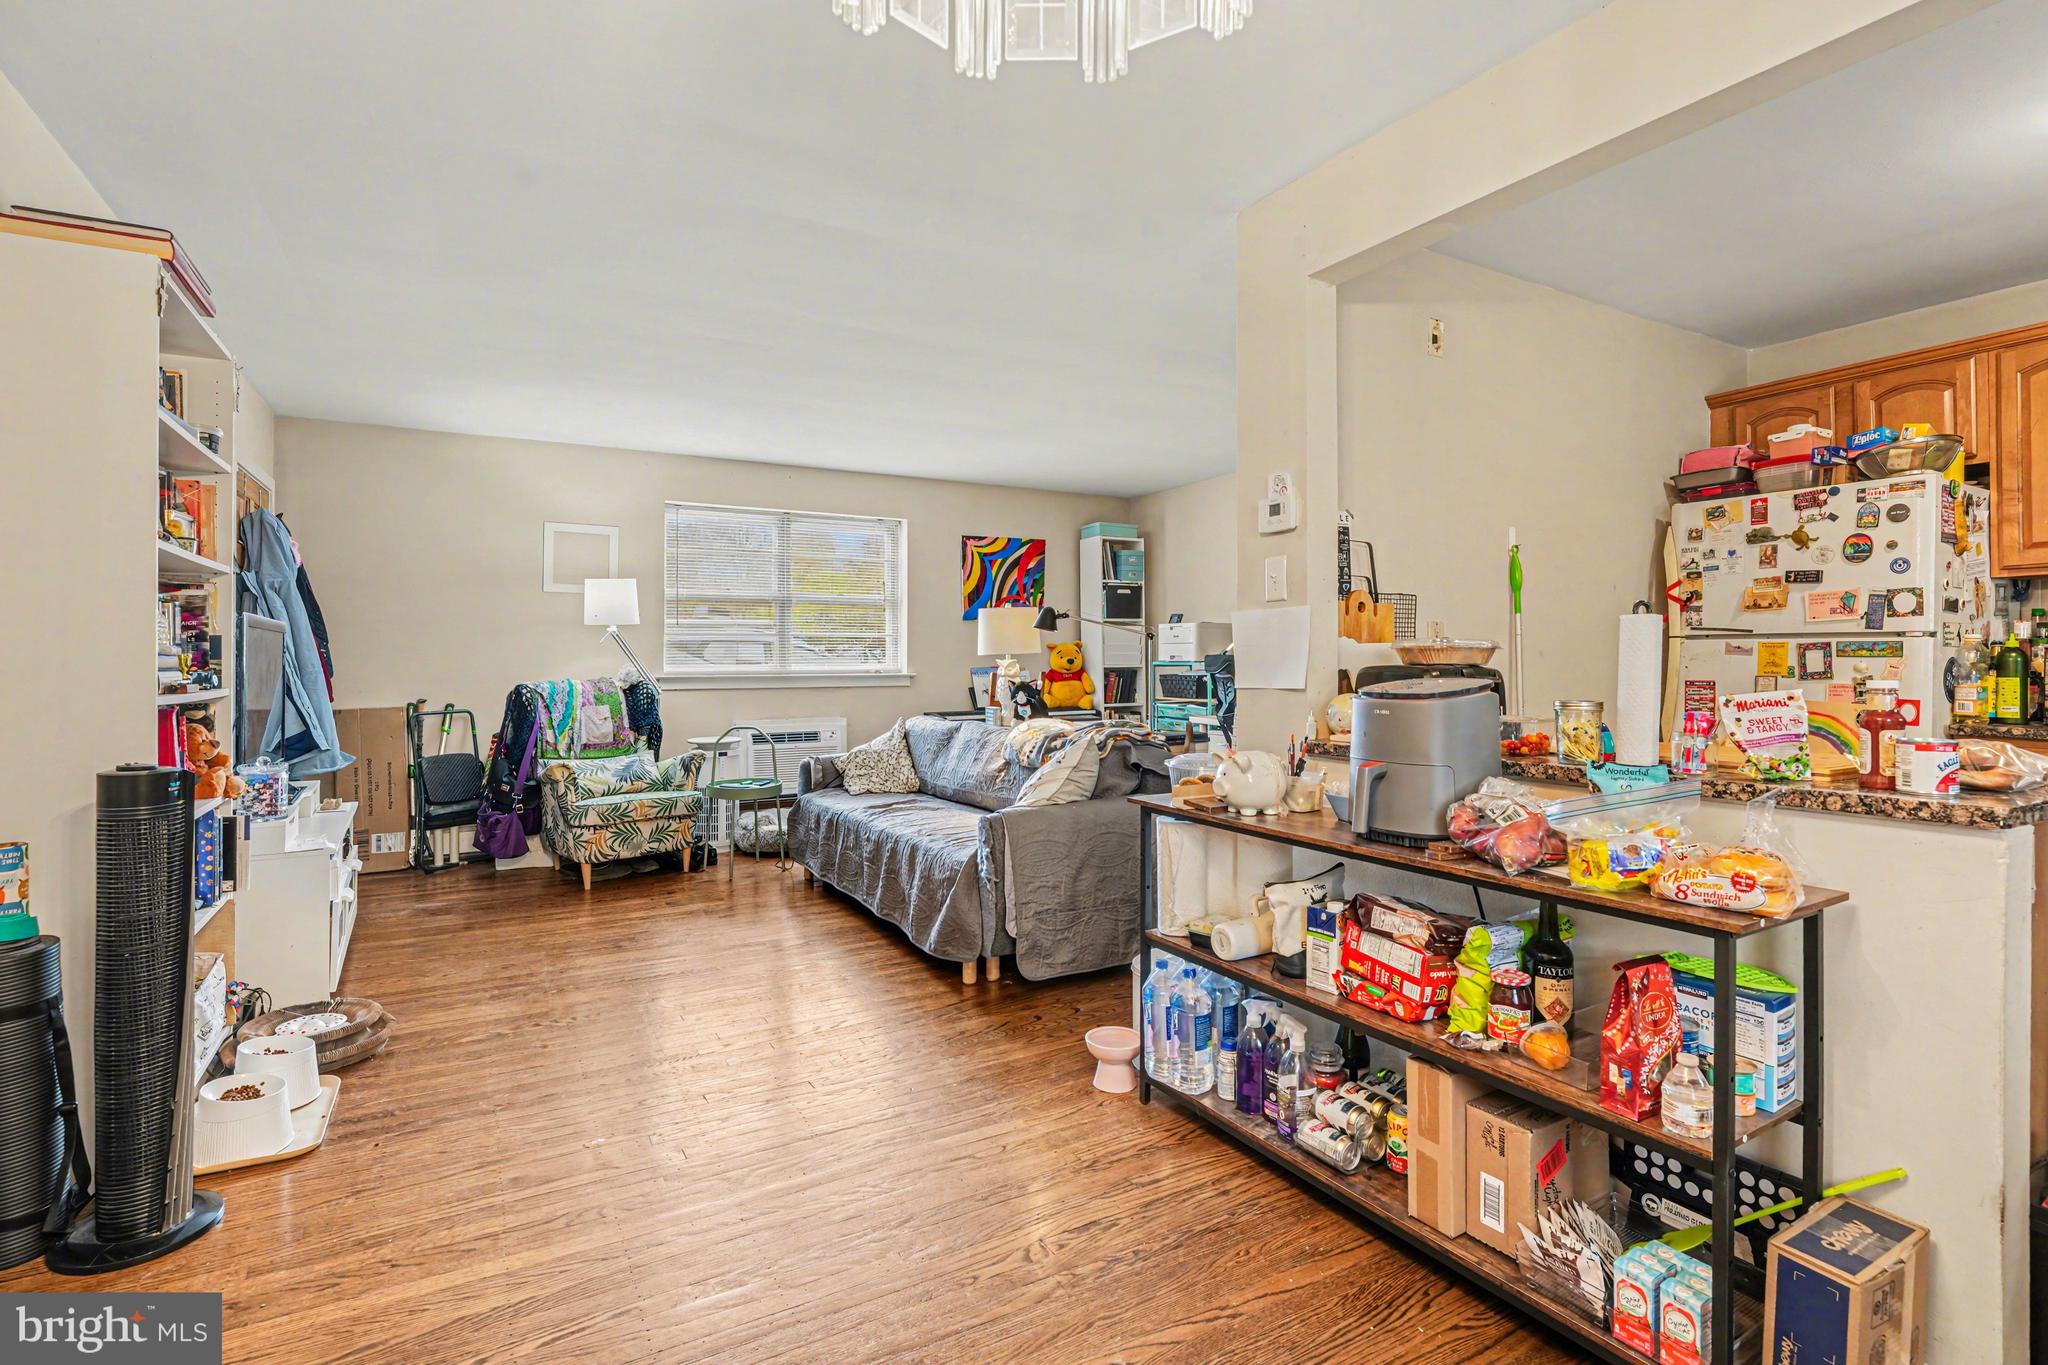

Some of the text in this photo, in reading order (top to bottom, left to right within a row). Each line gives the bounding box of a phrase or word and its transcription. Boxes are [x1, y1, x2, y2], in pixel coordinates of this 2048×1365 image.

[1853, 431, 1881, 447] Ziploc
[1733, 698, 1789, 712] Mariani
[1748, 717, 1783, 726] SWEET
[1756, 723, 1789, 733] TANGY
[1605, 767, 1649, 776] Wonderful
[1675, 884, 1741, 902] 8 Sandwich
[1820, 1219, 1874, 1251] chewy
